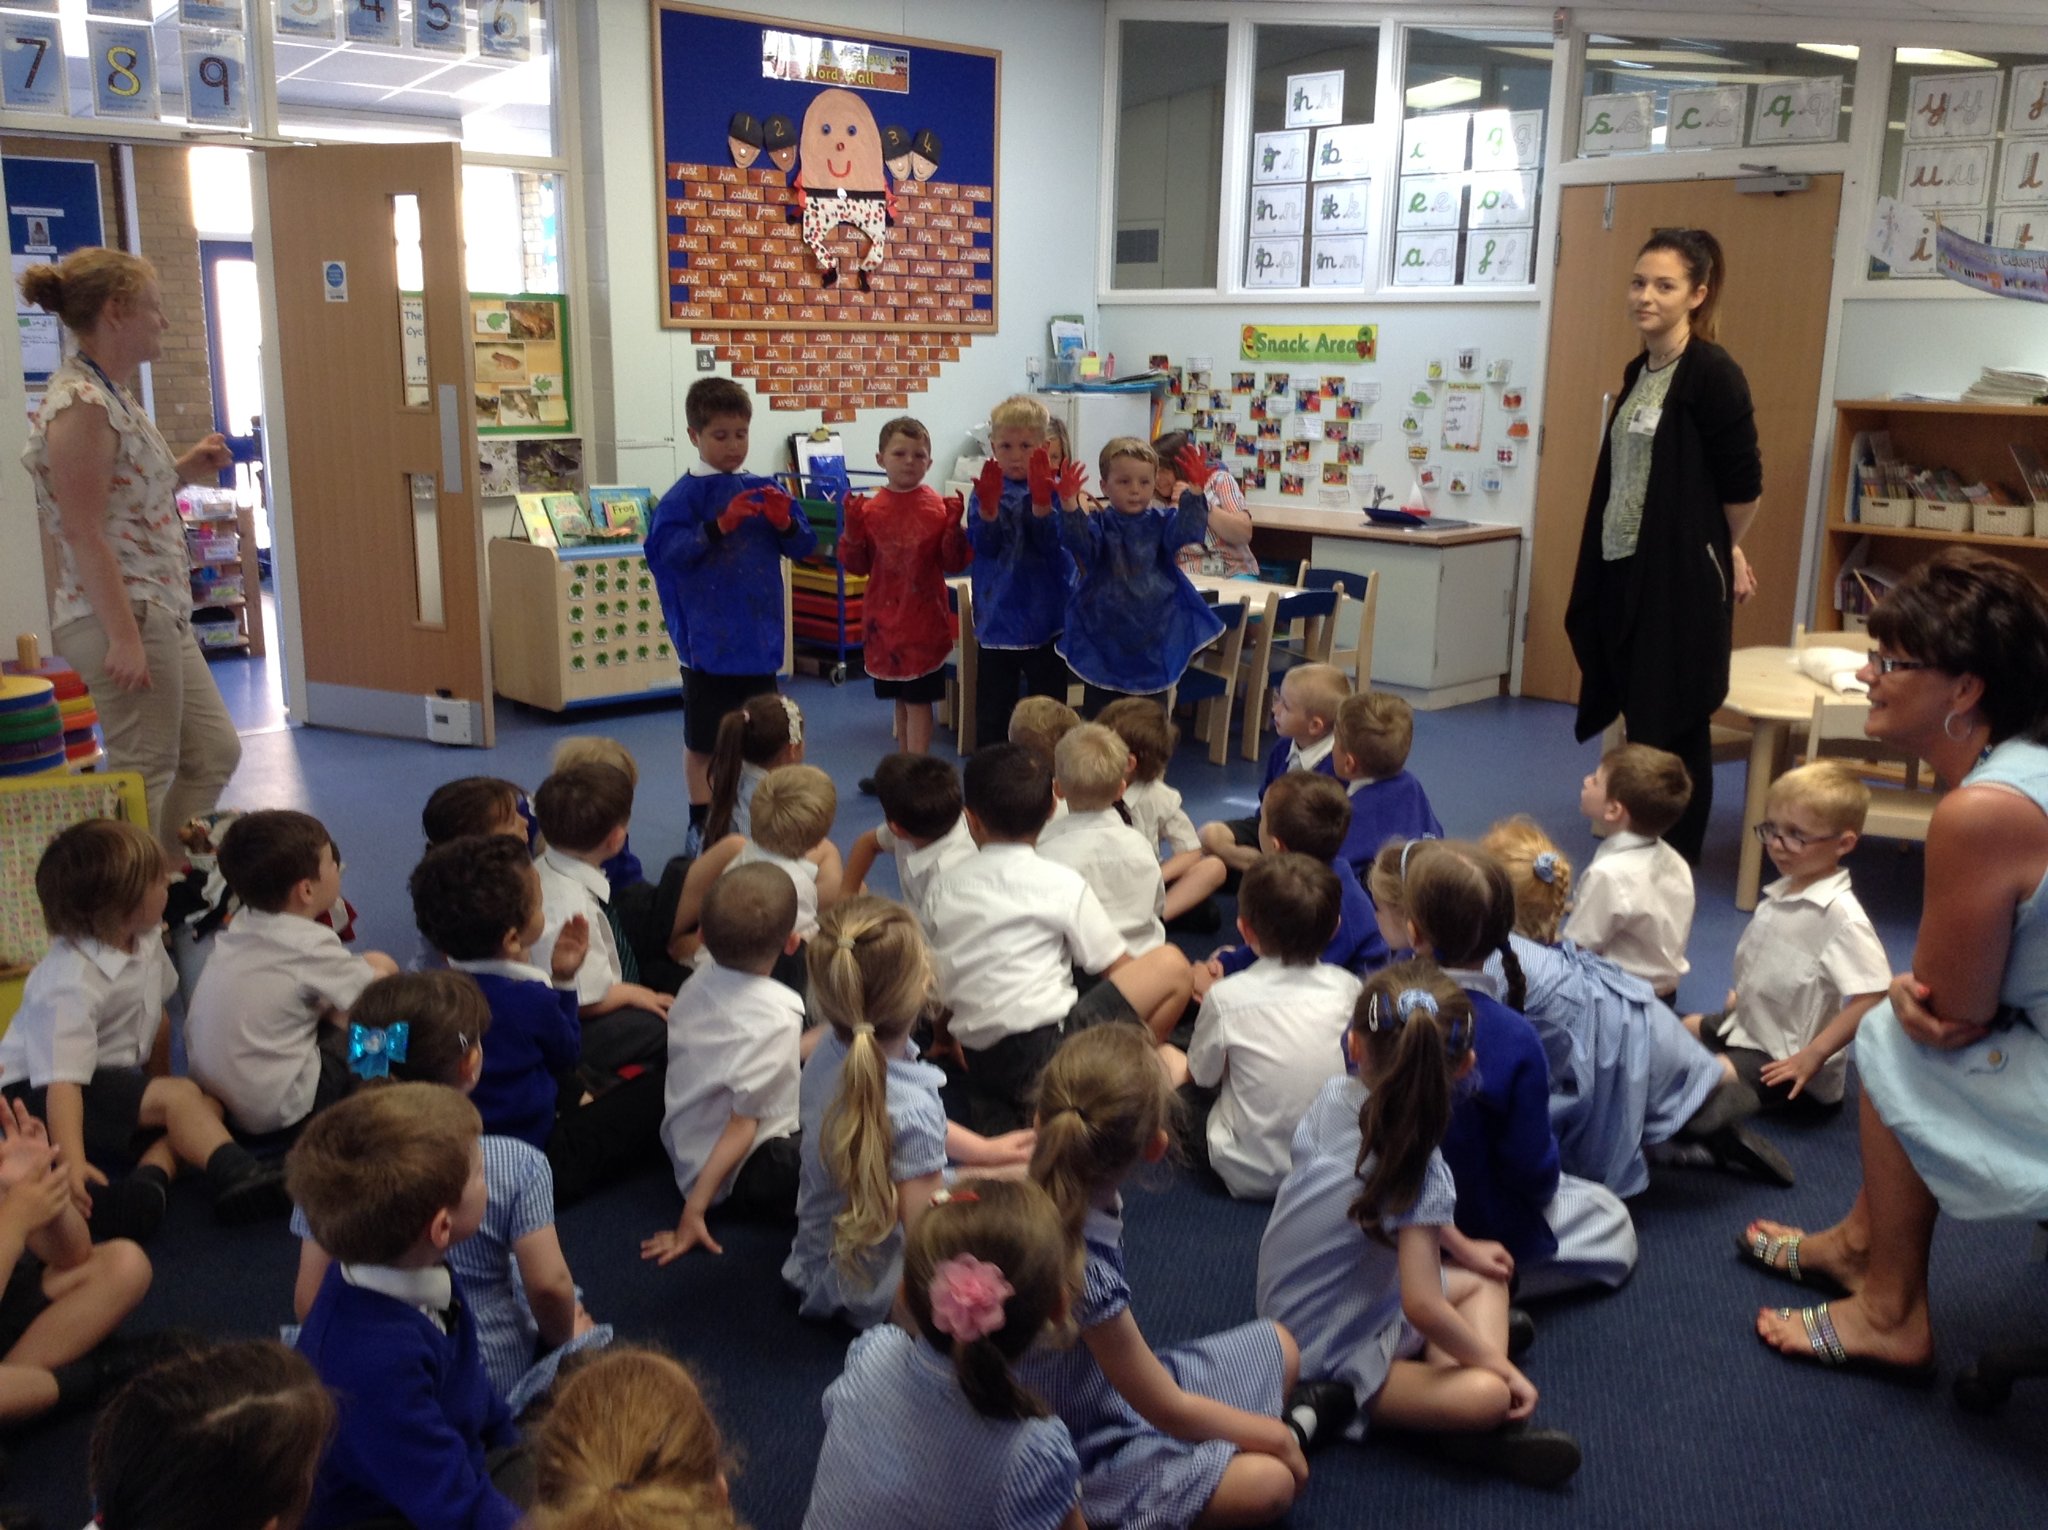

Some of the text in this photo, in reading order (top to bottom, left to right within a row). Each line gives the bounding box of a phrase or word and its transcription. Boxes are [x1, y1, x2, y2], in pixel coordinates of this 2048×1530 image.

[426, 0, 451, 31] 5
[493, 0, 517, 39] 6
[16, 38, 47, 89] 7
[106, 45, 141, 96] 8
[199, 57, 230, 105] 9
[2028, 81, 2048, 120] j
[1763, 95, 1795, 128] q
[1918, 92, 1948, 127] y
[745, 116, 750, 131] 1
[1587, 112, 1614, 135] s
[1676, 107, 1702, 130] c
[774, 120, 785, 137] 2
[888, 131, 899, 145] 3
[923, 133, 932, 152] 4
[677, 165, 698, 180] just
[718, 169, 737, 182] him
[1909, 166, 1943, 187] u
[696, 186, 713, 198] his
[730, 188, 759, 200] called
[675, 201, 699, 215] your
[1408, 192, 1428, 213] e
[712, 206, 743, 217] looked
[756, 206, 777, 220] from
[695, 222, 716, 233] here
[733, 224, 759, 235] what
[771, 226, 797, 237] could
[678, 238, 698, 249] that
[720, 241, 738, 250] one
[761, 242, 774, 252] do
[1909, 227, 1934, 262] i
[695, 257, 719, 266] saw
[735, 258, 759, 267] were
[1321, 256, 1337, 269] m
[1401, 248, 1425, 267] a
[1478, 240, 1496, 275] f
[773, 258, 796, 269] there
[849, 260, 860, 271] lik
[915, 261, 936, 274] have
[948, 265, 968, 276] make
[678, 273, 700, 284] and
[719, 274, 737, 286] you
[759, 273, 777, 287] they
[798, 276, 812, 286] all
[965, 282, 986, 292] down
[695, 289, 723, 302] people
[741, 290, 753, 301] he
[777, 291, 794, 303] she
[815, 294, 830, 302] we
[404, 311, 422, 321] The
[680, 307, 704, 317] their
[763, 308, 775, 320] go
[801, 308, 813, 317] no
[839, 310, 848, 319] to
[871, 310, 885, 321] the
[406, 327, 423, 338] Cyc
[700, 332, 720, 342] time
[744, 333, 757, 342] as
[816, 333, 832, 342] can
[780, 333, 796, 344] old
[1255, 332, 1358, 353] Snack Area
[728, 348, 741, 361] big
[766, 350, 779, 358] an
[801, 349, 817, 360] but
[835, 349, 853, 359] dad
[417, 356, 428, 366] Fr
[741, 366, 760, 376] will
[776, 365, 799, 374] mum
[816, 363, 831, 377] got
[848, 363, 867, 376] very
[769, 382, 779, 392] is
[798, 381, 823, 392] asked
[867, 379, 892, 390] house
[906, 379, 920, 390] not
[776, 398, 800, 407] went
[850, 397, 865, 408] day
[834, 411, 844, 421] a
[612, 504, 635, 517] Frog
